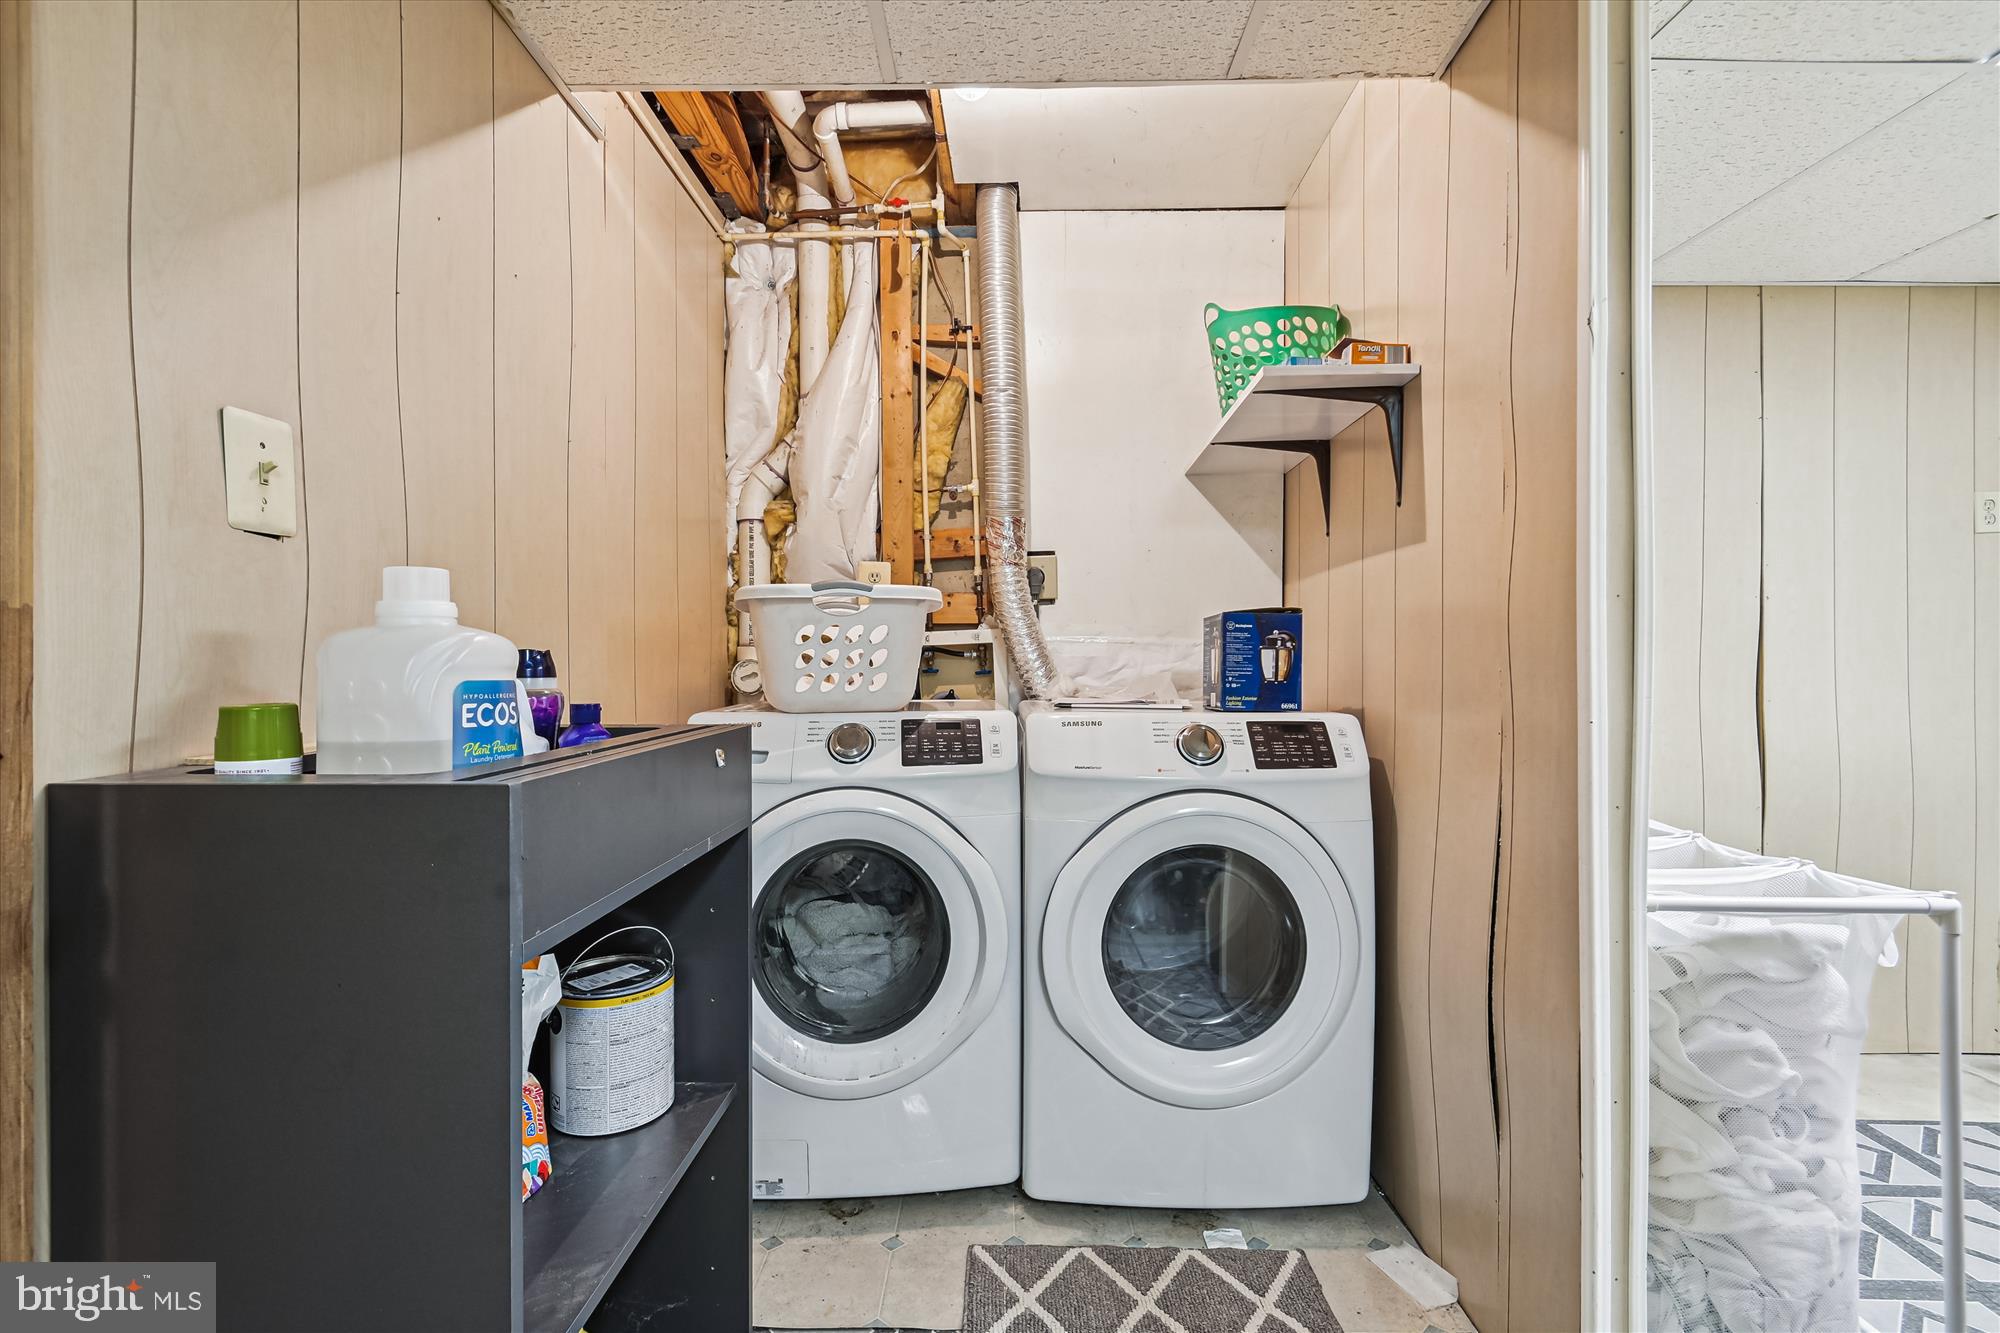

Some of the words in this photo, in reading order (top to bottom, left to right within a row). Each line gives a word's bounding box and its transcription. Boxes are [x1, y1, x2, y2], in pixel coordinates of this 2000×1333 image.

[461, 702, 518, 728] ECOS
[462, 742, 491, 757] Plant
[470, 755, 494, 763] Laundry
